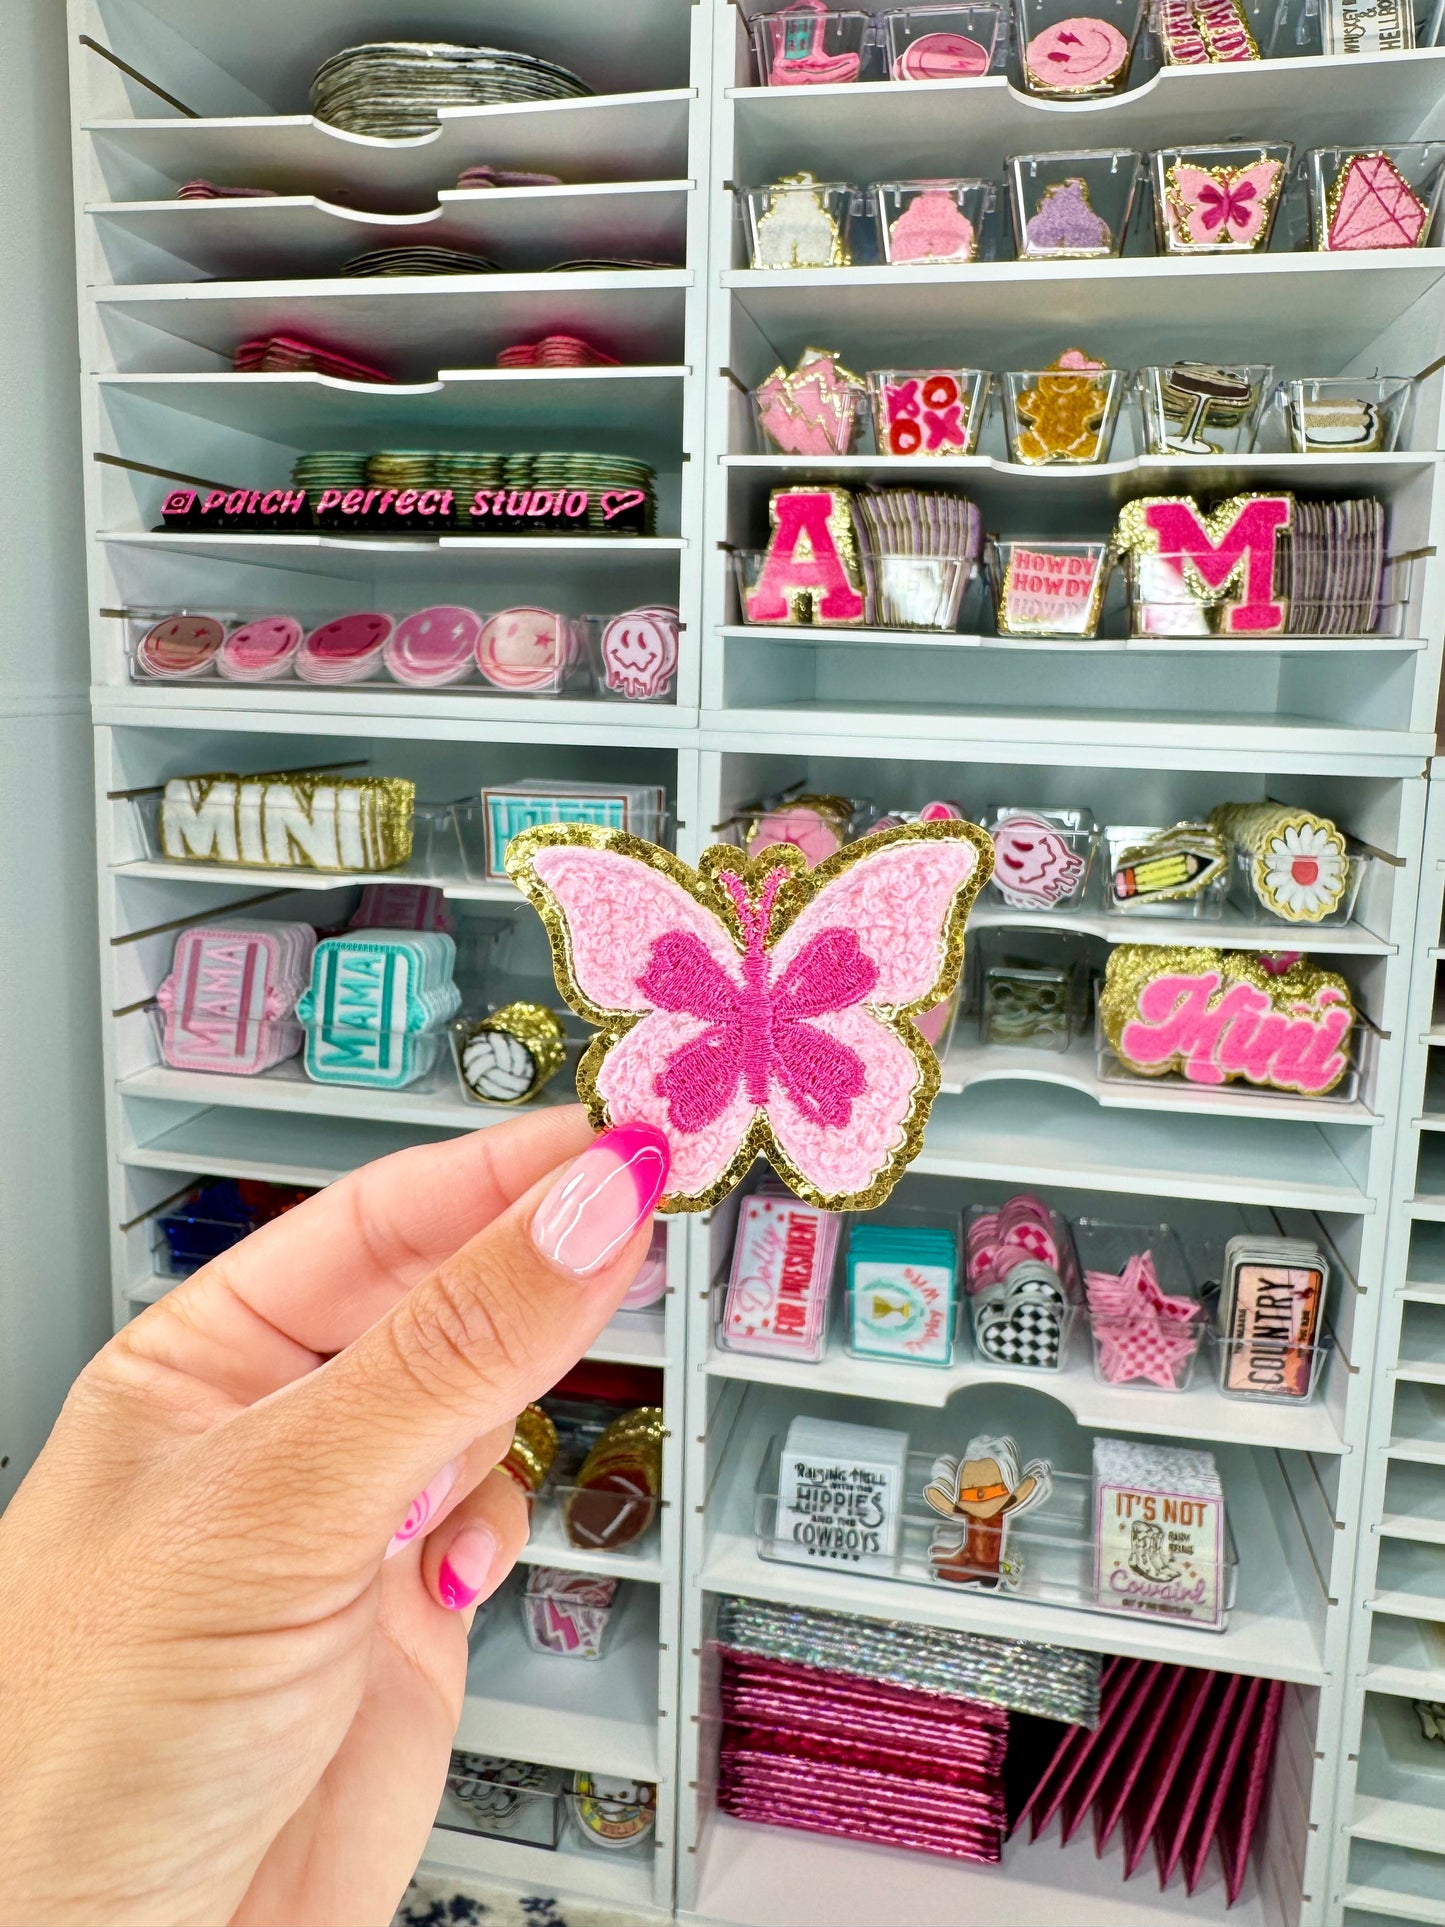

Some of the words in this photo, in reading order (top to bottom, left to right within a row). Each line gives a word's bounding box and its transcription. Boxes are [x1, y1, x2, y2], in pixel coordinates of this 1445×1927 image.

[746, 492, 863, 619] A
[1012, 572, 1092, 598] HOWDY
[1016, 551, 1095, 576] HOWDY
[1145, 500, 1289, 630] M
[165, 779, 365, 869] MINI
[177, 940, 247, 1058] MAMA
[319, 954, 382, 1070] MAMA
[1123, 973, 1350, 1092] Mini
[778, 1211, 818, 1302] PRESIDENT
[772, 1302, 807, 1337] FOR
[1248, 1277, 1295, 1384] COUNTRY
[793, 1522, 880, 1552] COWBOYS
[796, 1485, 885, 1528] HIPPIES
[1116, 1492, 1157, 1521] IT'S
[1163, 1498, 1208, 1528] NOT
